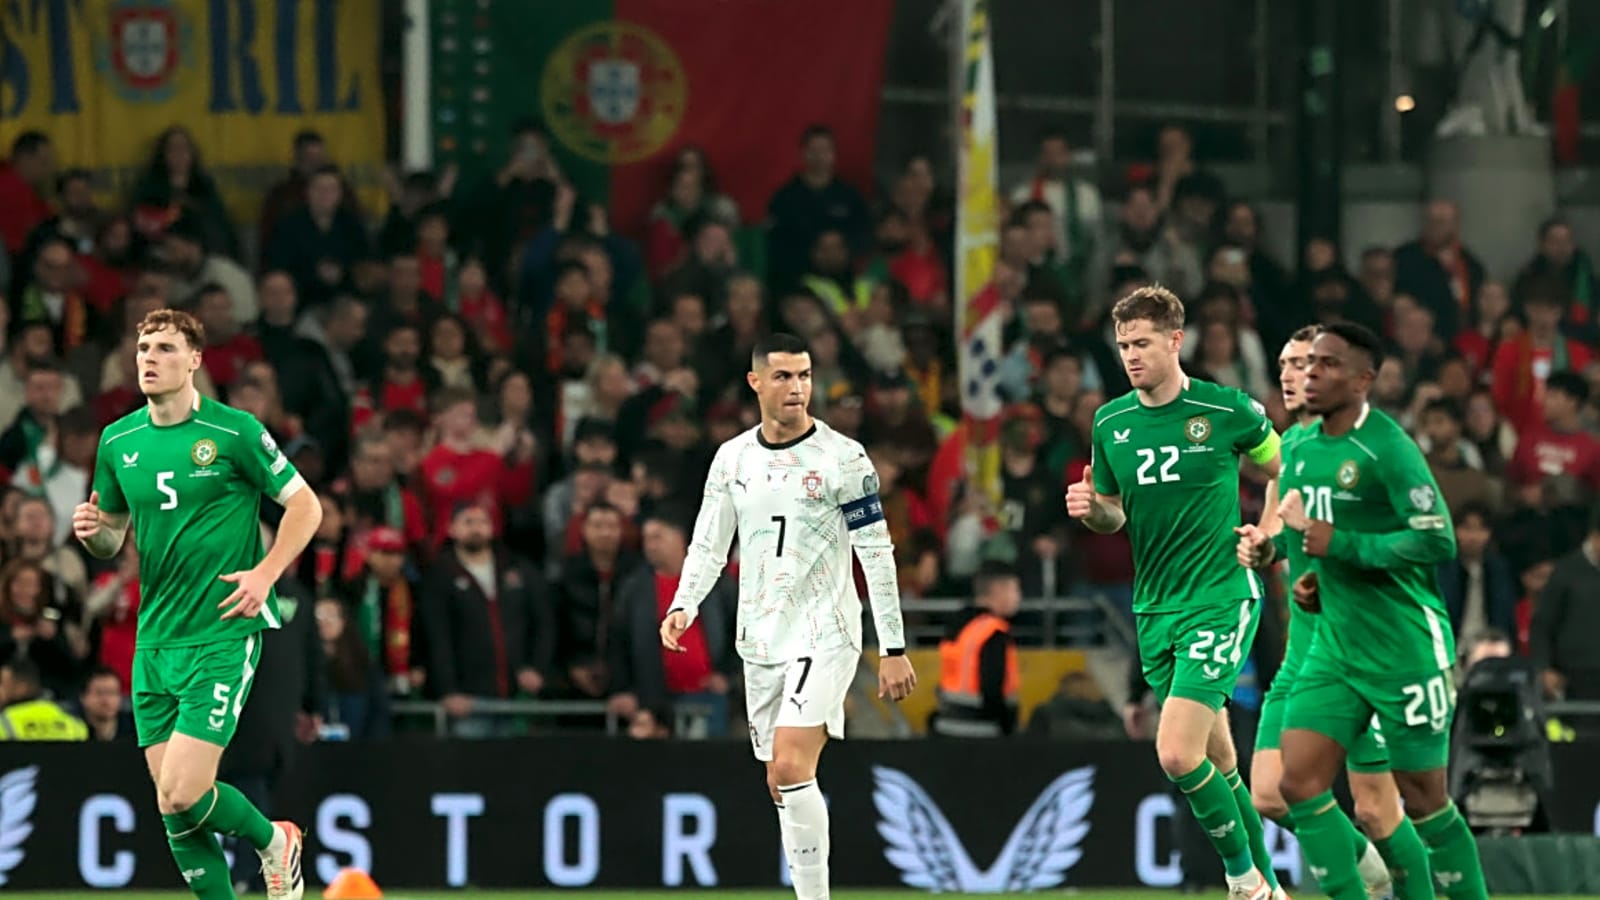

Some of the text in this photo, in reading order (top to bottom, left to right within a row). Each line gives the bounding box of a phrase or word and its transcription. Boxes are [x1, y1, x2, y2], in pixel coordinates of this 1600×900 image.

[1136, 445, 1181, 485] 22
[157, 470, 178, 510] 5
[1302, 484, 1334, 525] 20
[771, 515, 786, 558] 7
[1189, 630, 1236, 665] 22
[794, 656, 813, 694] 7
[210, 682, 231, 717] 5
[1401, 675, 1448, 726] 20
[79, 793, 829, 887] CSTOR
